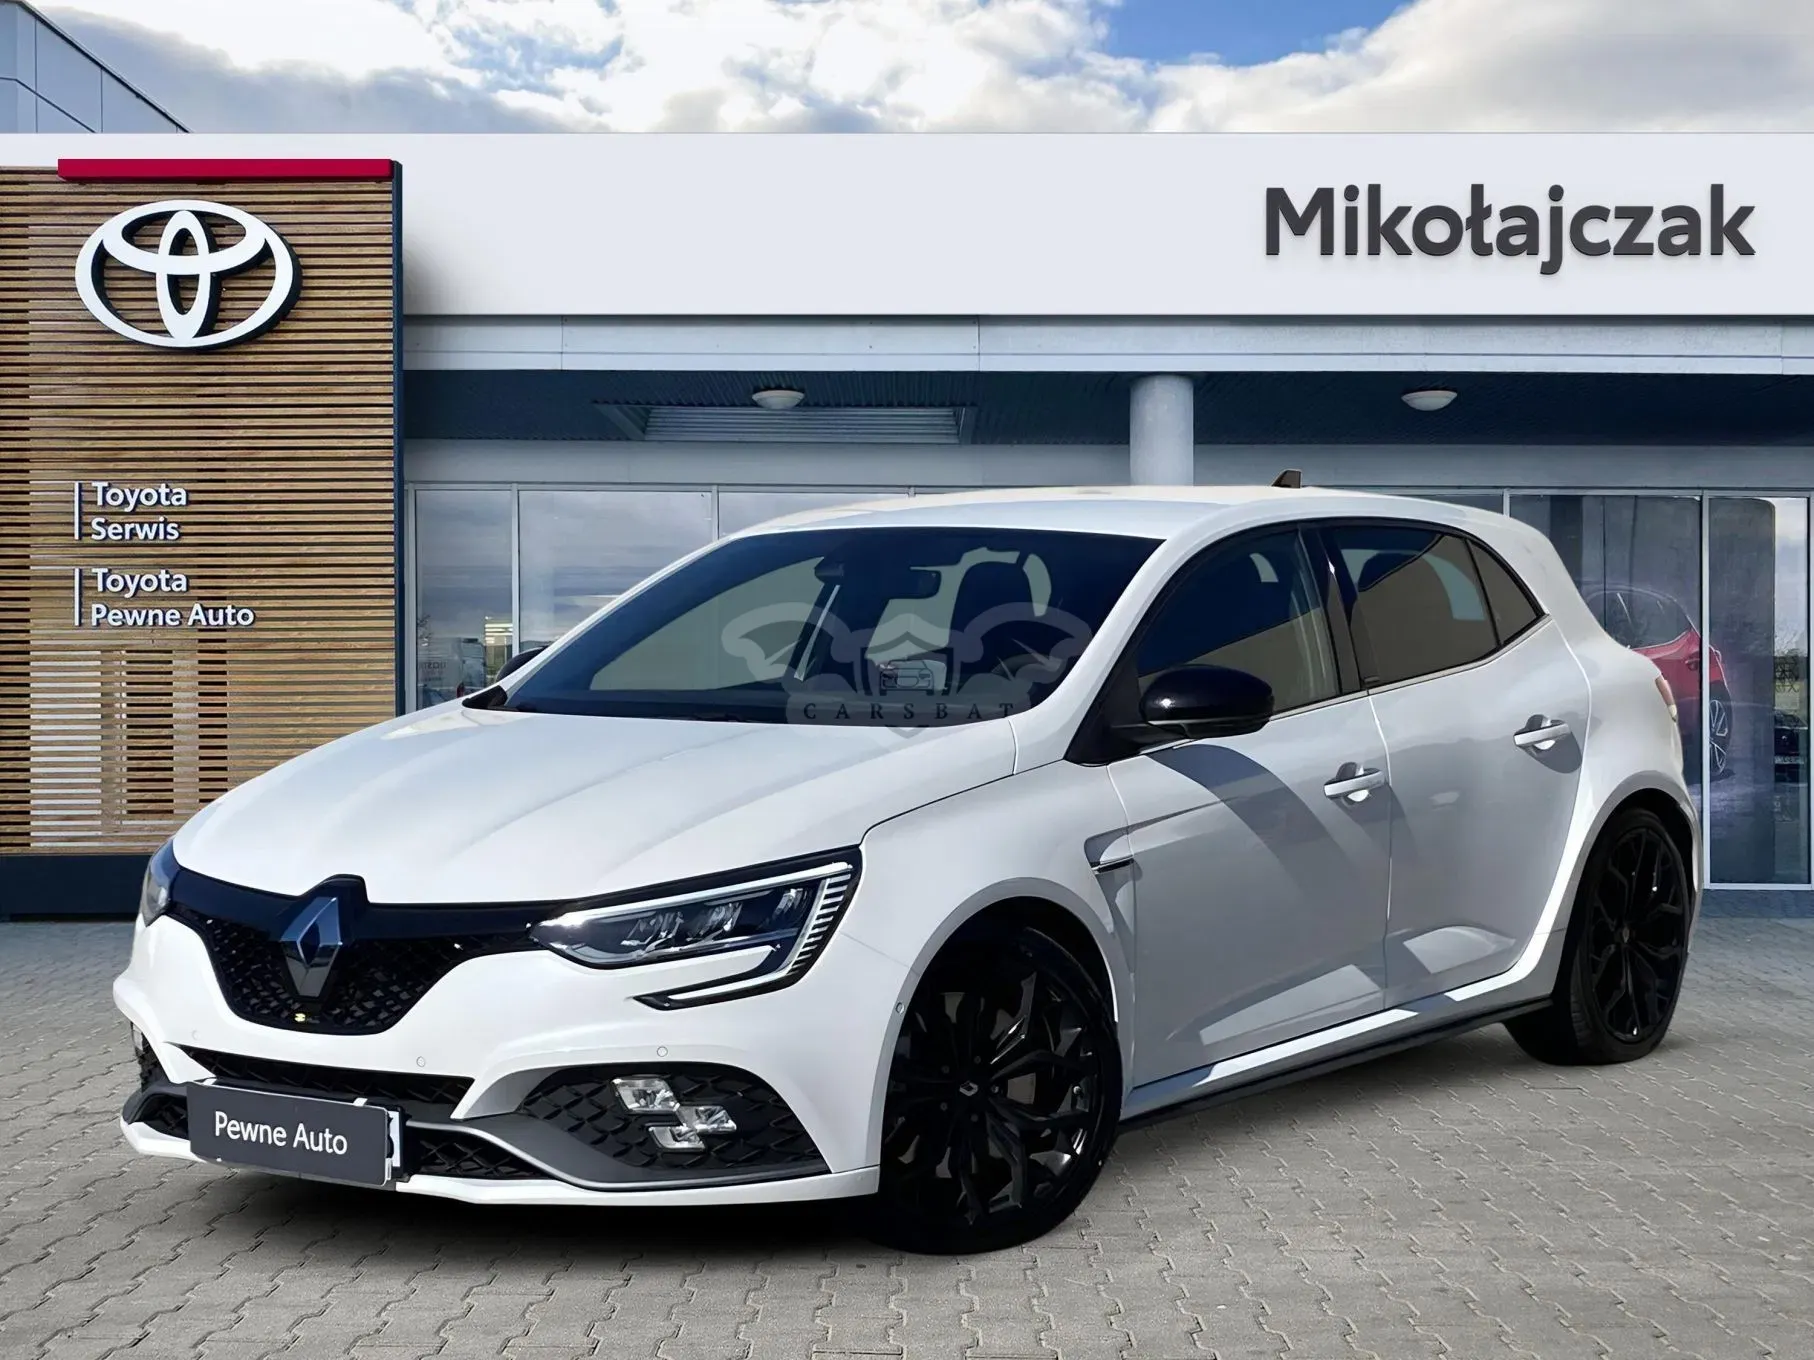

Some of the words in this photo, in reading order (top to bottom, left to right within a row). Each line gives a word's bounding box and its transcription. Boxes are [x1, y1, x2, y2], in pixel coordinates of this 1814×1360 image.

[1265, 183, 1756, 275] Mikołajczak
[91, 481, 187, 511] Toyota
[91, 516, 179, 540] Serwis
[91, 567, 187, 598] Toyota
[91, 603, 181, 626] Pewne
[187, 603, 254, 626] Auto
[215, 1110, 287, 1147] Pewne
[292, 1122, 348, 1155] Auto
